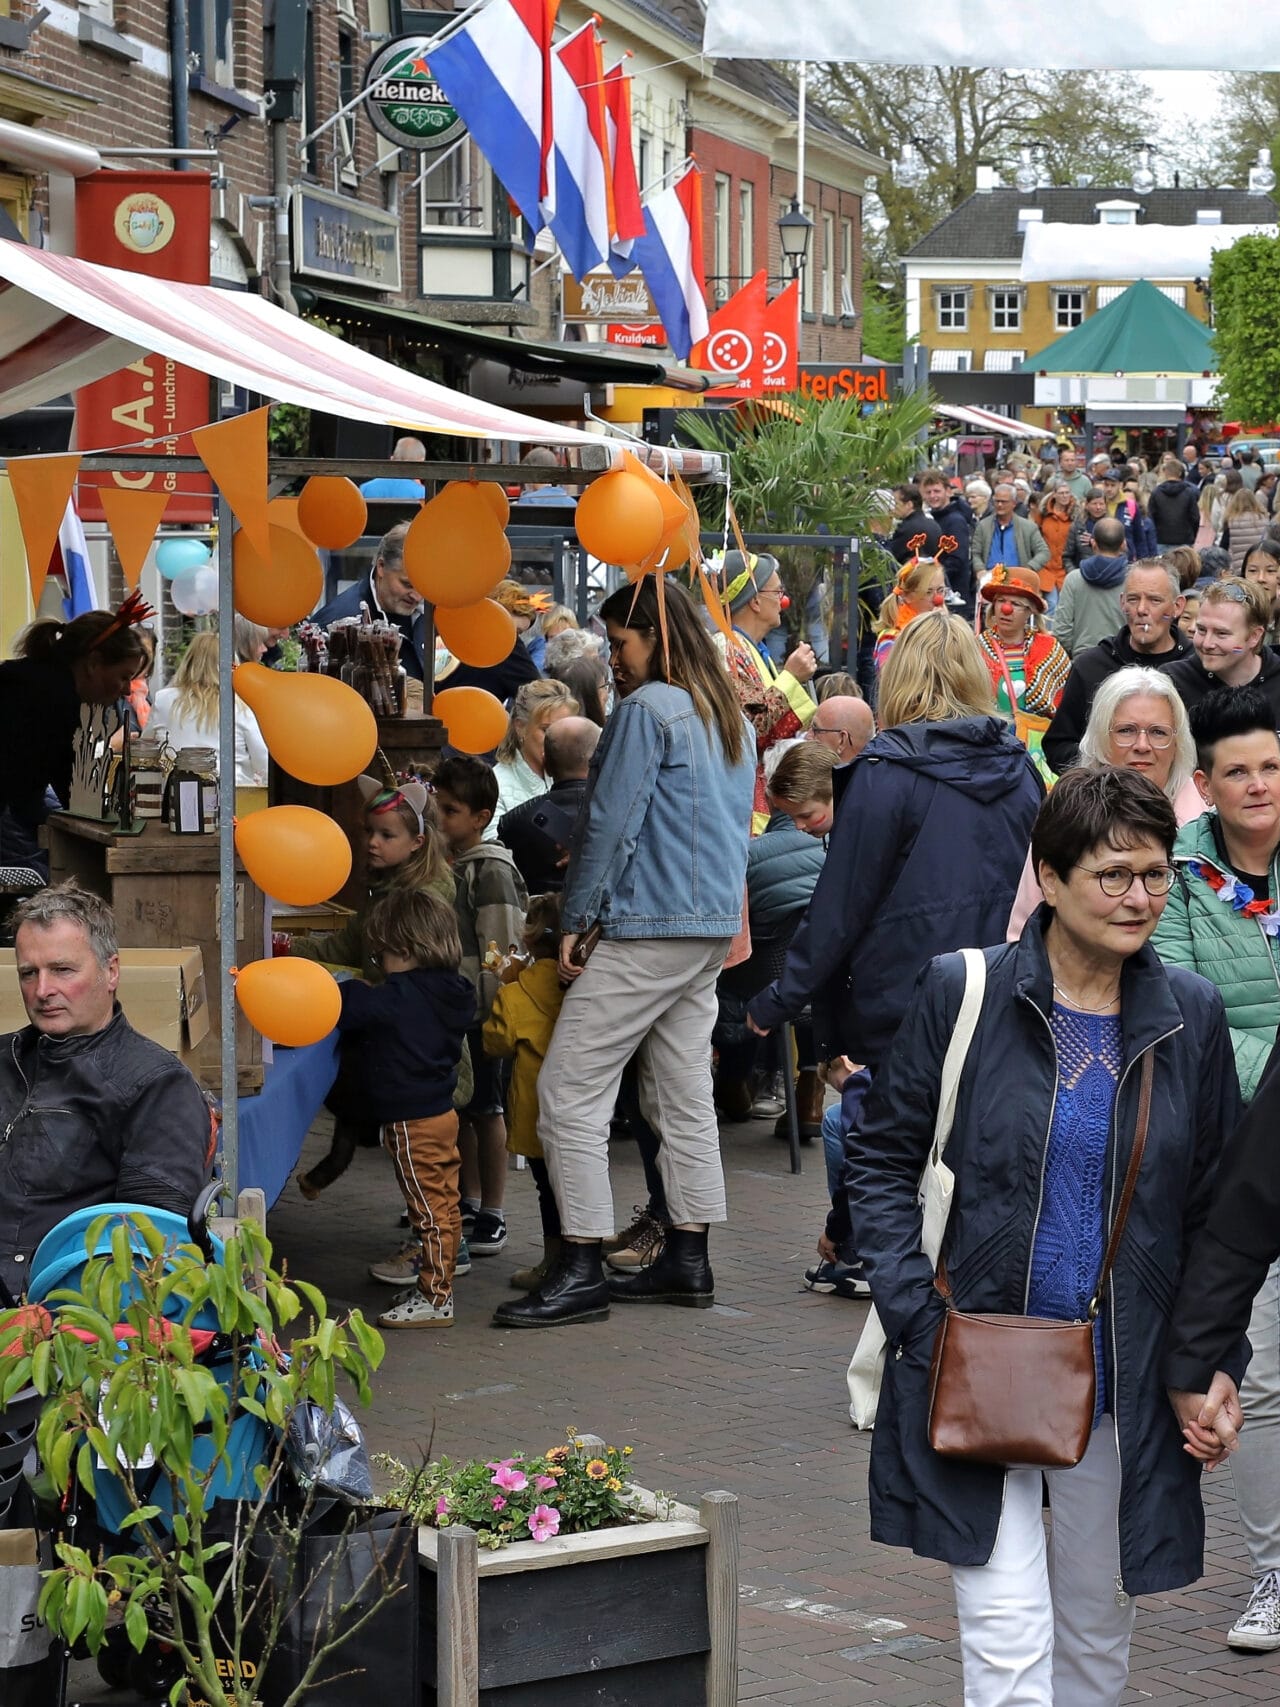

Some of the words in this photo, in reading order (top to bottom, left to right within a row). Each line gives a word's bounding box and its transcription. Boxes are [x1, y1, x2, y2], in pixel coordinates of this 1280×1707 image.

[372, 81, 449, 103] Heinek
[614, 332, 657, 345] Kruidvat
[162, 356, 176, 419] Lunchro
